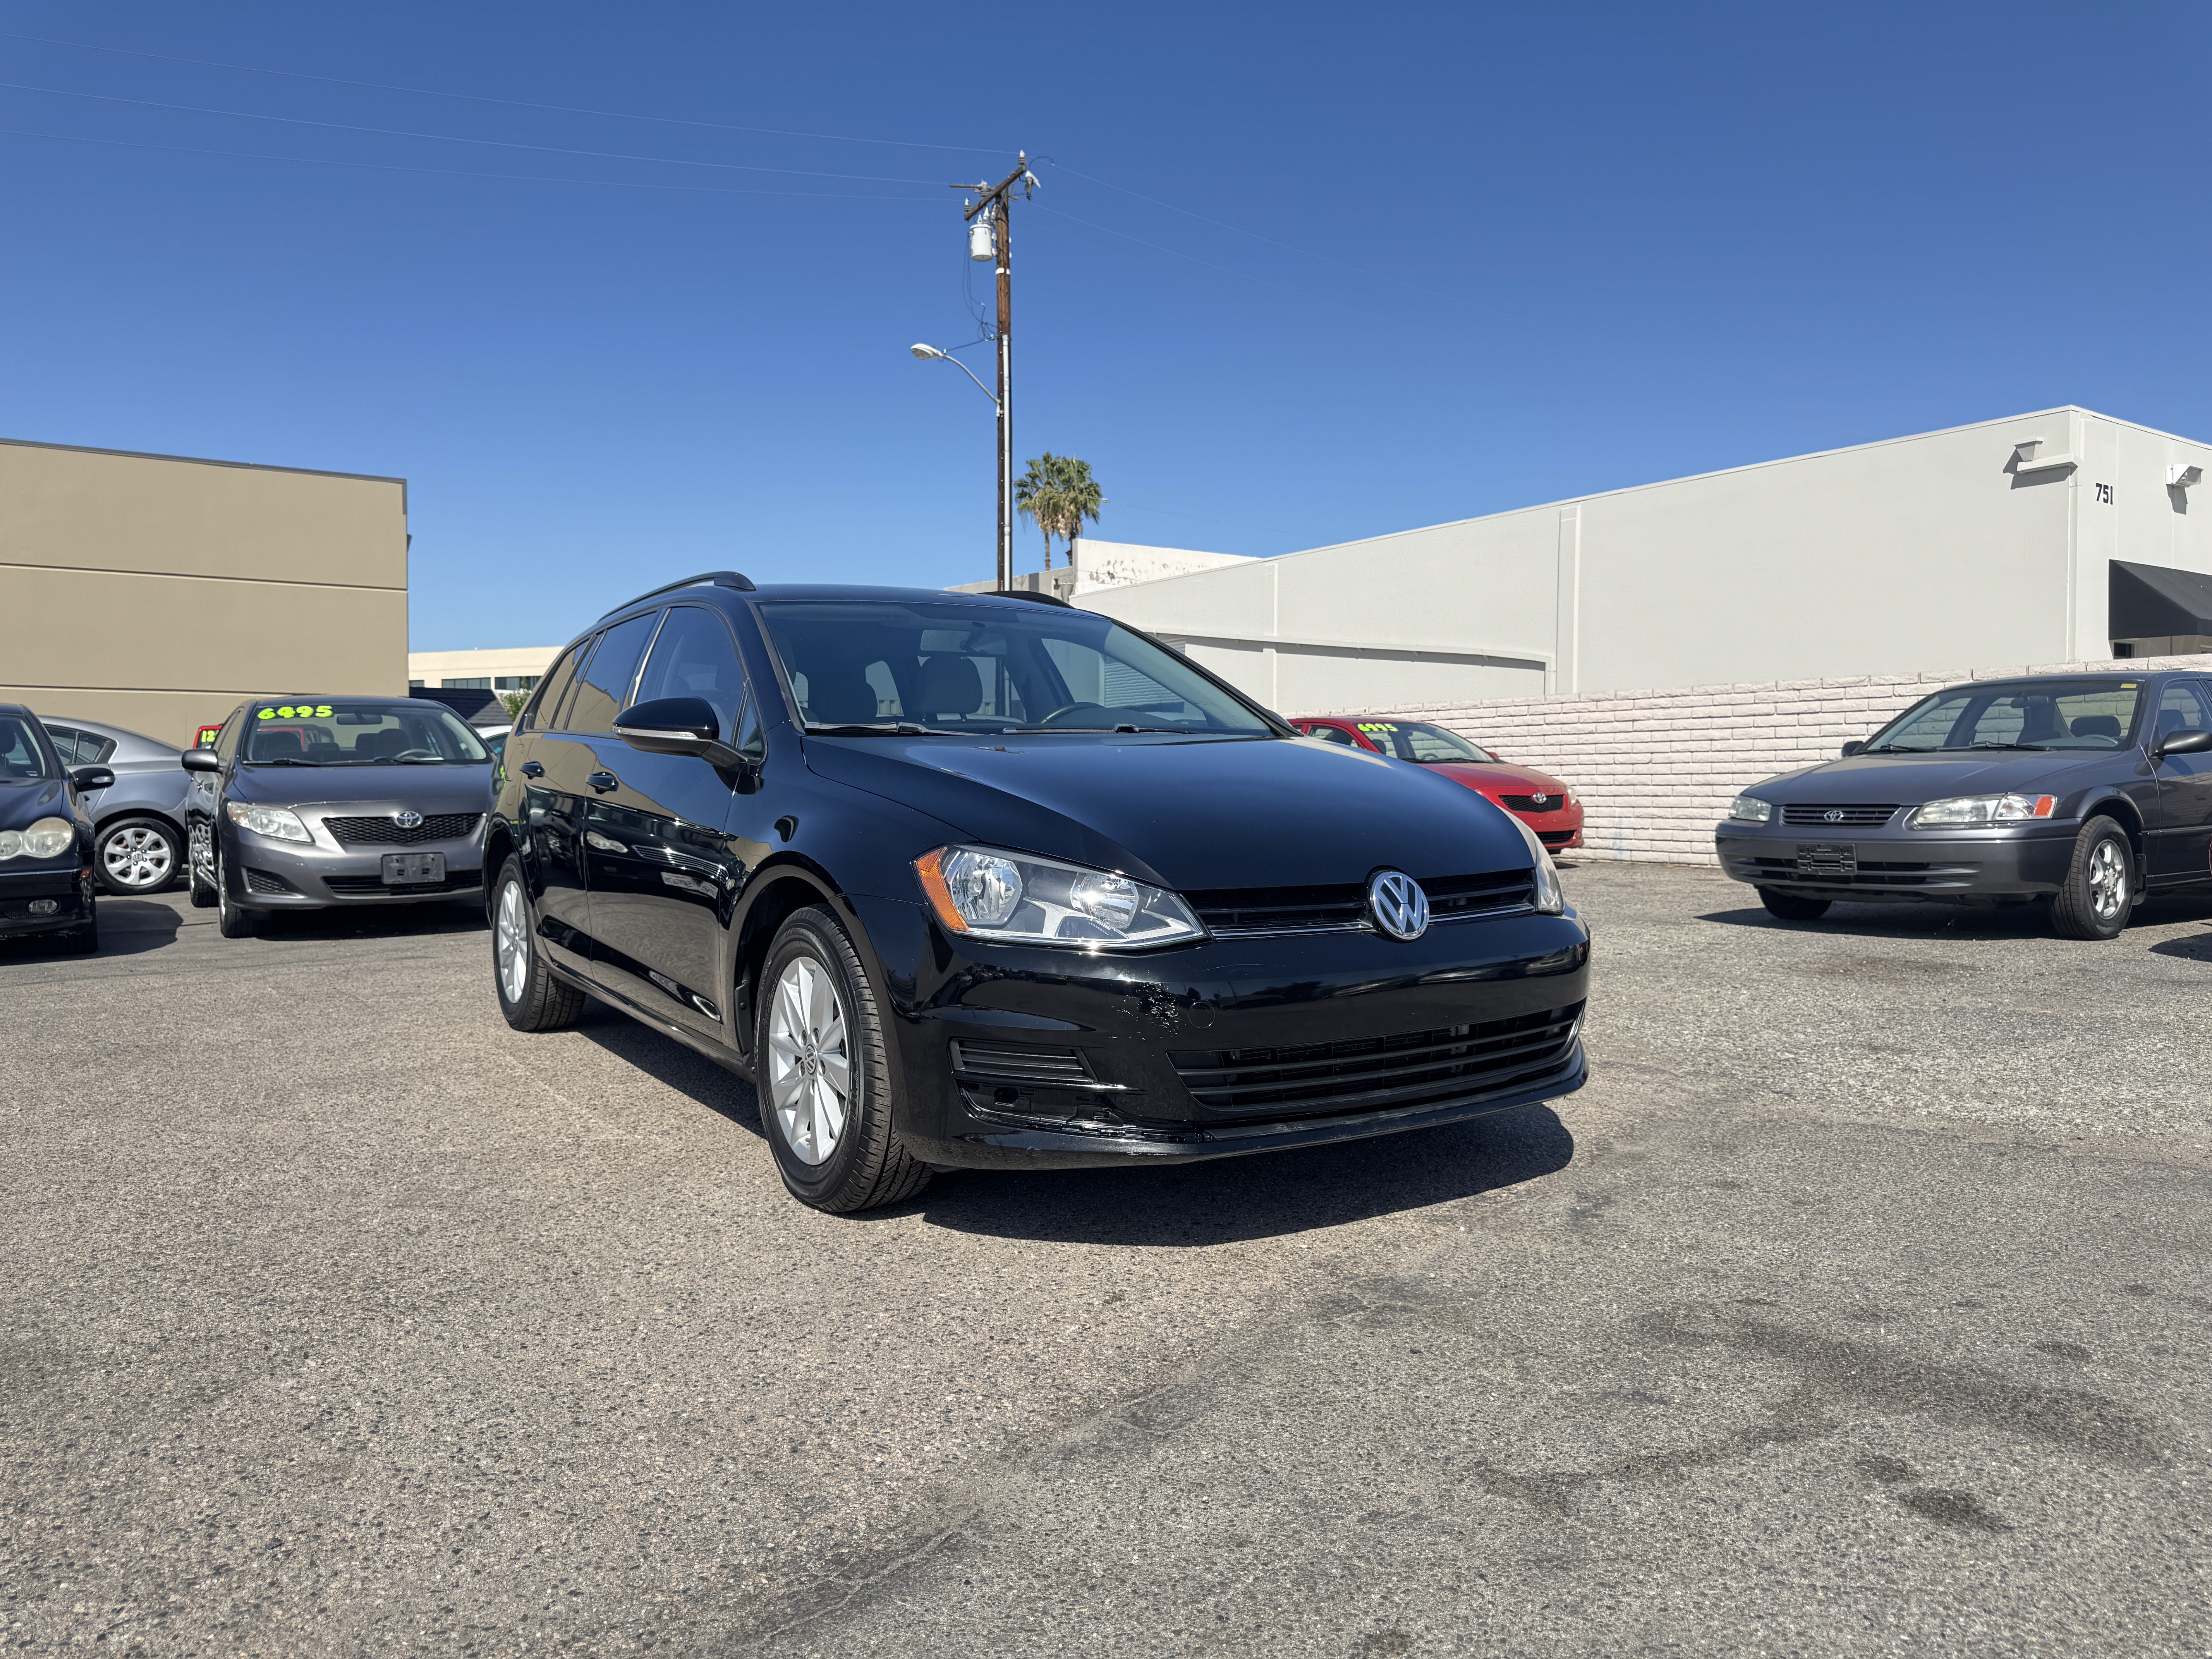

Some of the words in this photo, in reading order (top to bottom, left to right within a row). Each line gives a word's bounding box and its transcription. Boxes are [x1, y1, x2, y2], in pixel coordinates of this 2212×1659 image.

[2095, 483, 2113, 505] 751
[258, 706, 333, 720] 6495
[1357, 723, 1399, 732] 6995
[1373, 871, 1429, 939] VW
